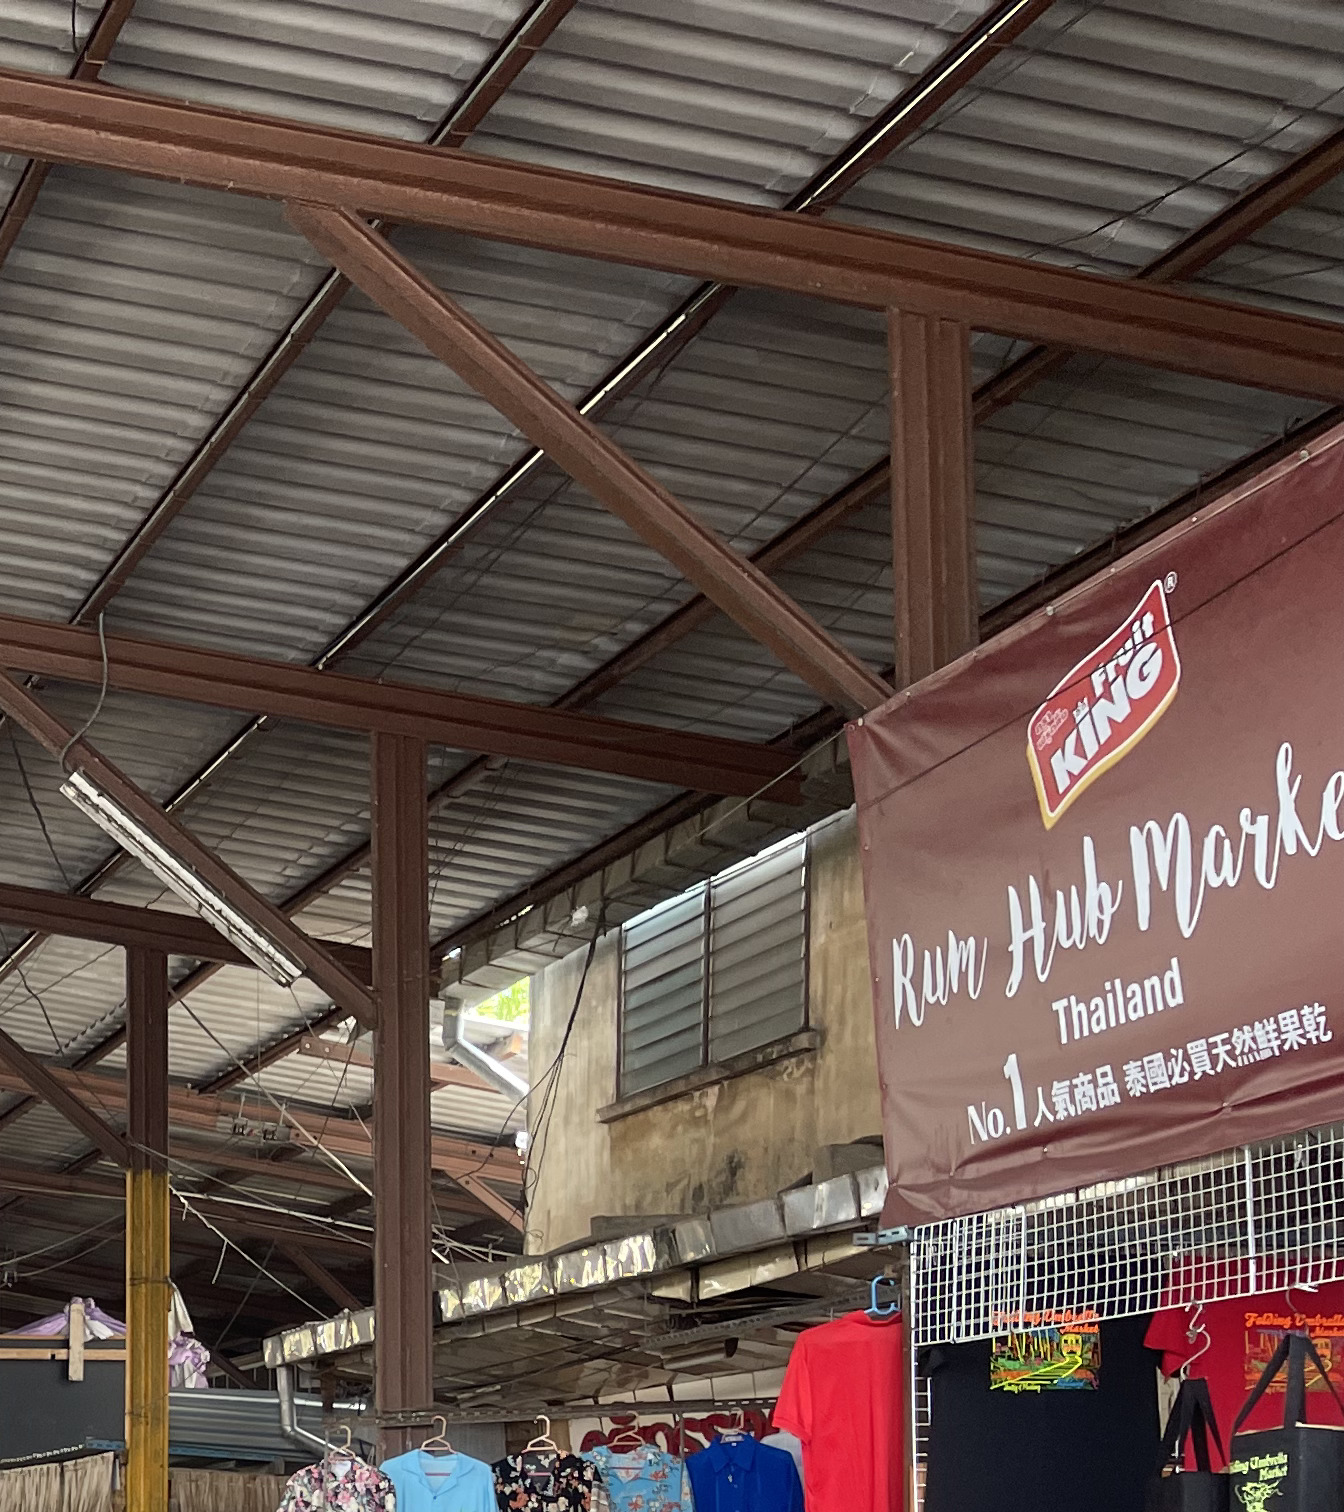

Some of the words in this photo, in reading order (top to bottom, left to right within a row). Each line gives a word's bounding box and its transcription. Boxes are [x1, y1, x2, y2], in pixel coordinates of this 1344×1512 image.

[1091, 611, 1154, 697] Fruit
[1050, 642, 1163, 794] KING
[1006, 835, 1122, 997] Hub
[1052, 957, 1185, 1044] Thailand
[1034, 1065, 1121, 1127] 人氣商品
[1123, 1002, 1333, 1098] 泰國必買天然鮮果乾
[1059, 1323, 1100, 1335] Market
[1245, 1312, 1292, 1328] Folding
